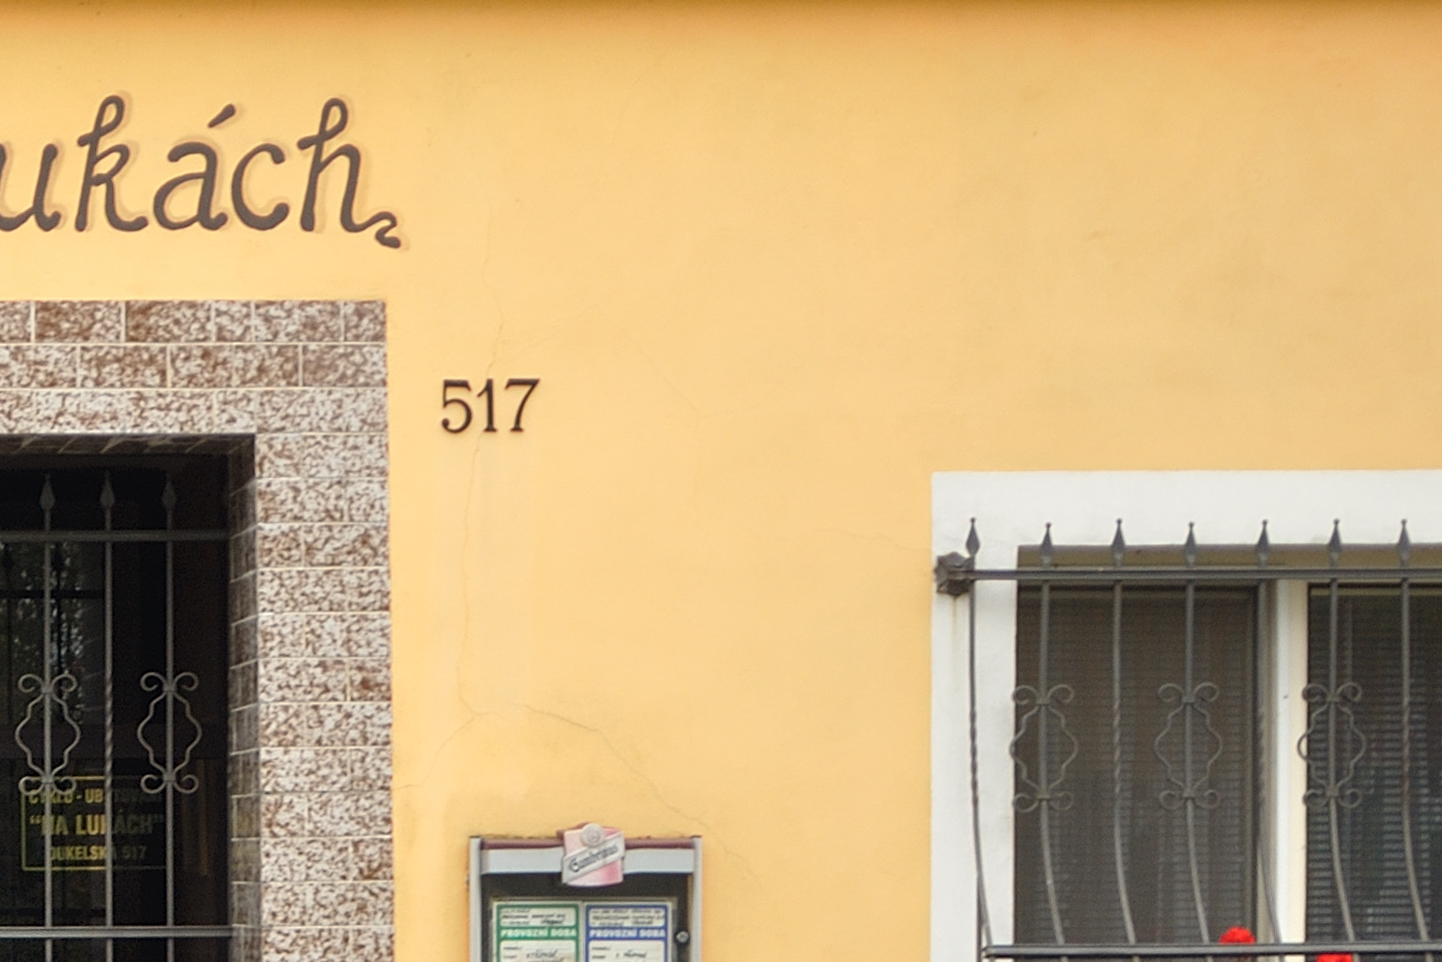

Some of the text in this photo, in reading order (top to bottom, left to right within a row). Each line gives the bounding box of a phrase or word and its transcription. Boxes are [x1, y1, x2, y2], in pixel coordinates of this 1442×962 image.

[442, 379, 539, 433] 517
[588, 928, 665, 938] PROVOZNÍ DOBA
